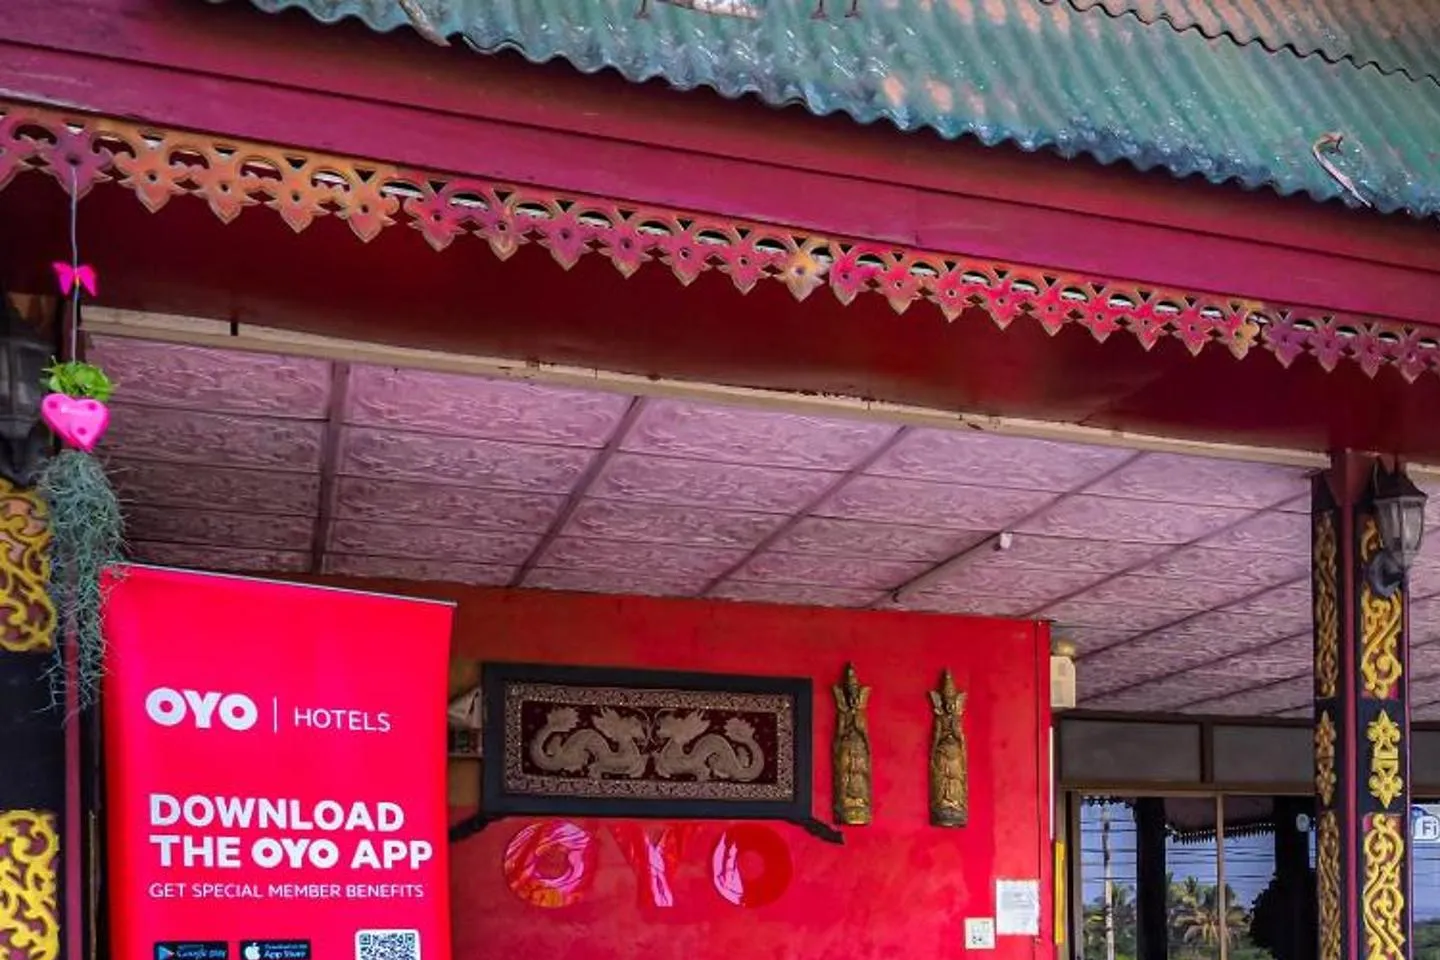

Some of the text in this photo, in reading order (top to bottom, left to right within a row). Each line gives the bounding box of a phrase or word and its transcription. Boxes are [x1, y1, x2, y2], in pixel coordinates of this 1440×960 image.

[145, 687, 391, 732] OYO HOTELS
[149, 793, 404, 832] DOWNLOAD
[149, 834, 433, 870] THE OYO APP
[149, 882, 424, 898] GET SPECIAL MEMBER BENEFITS
